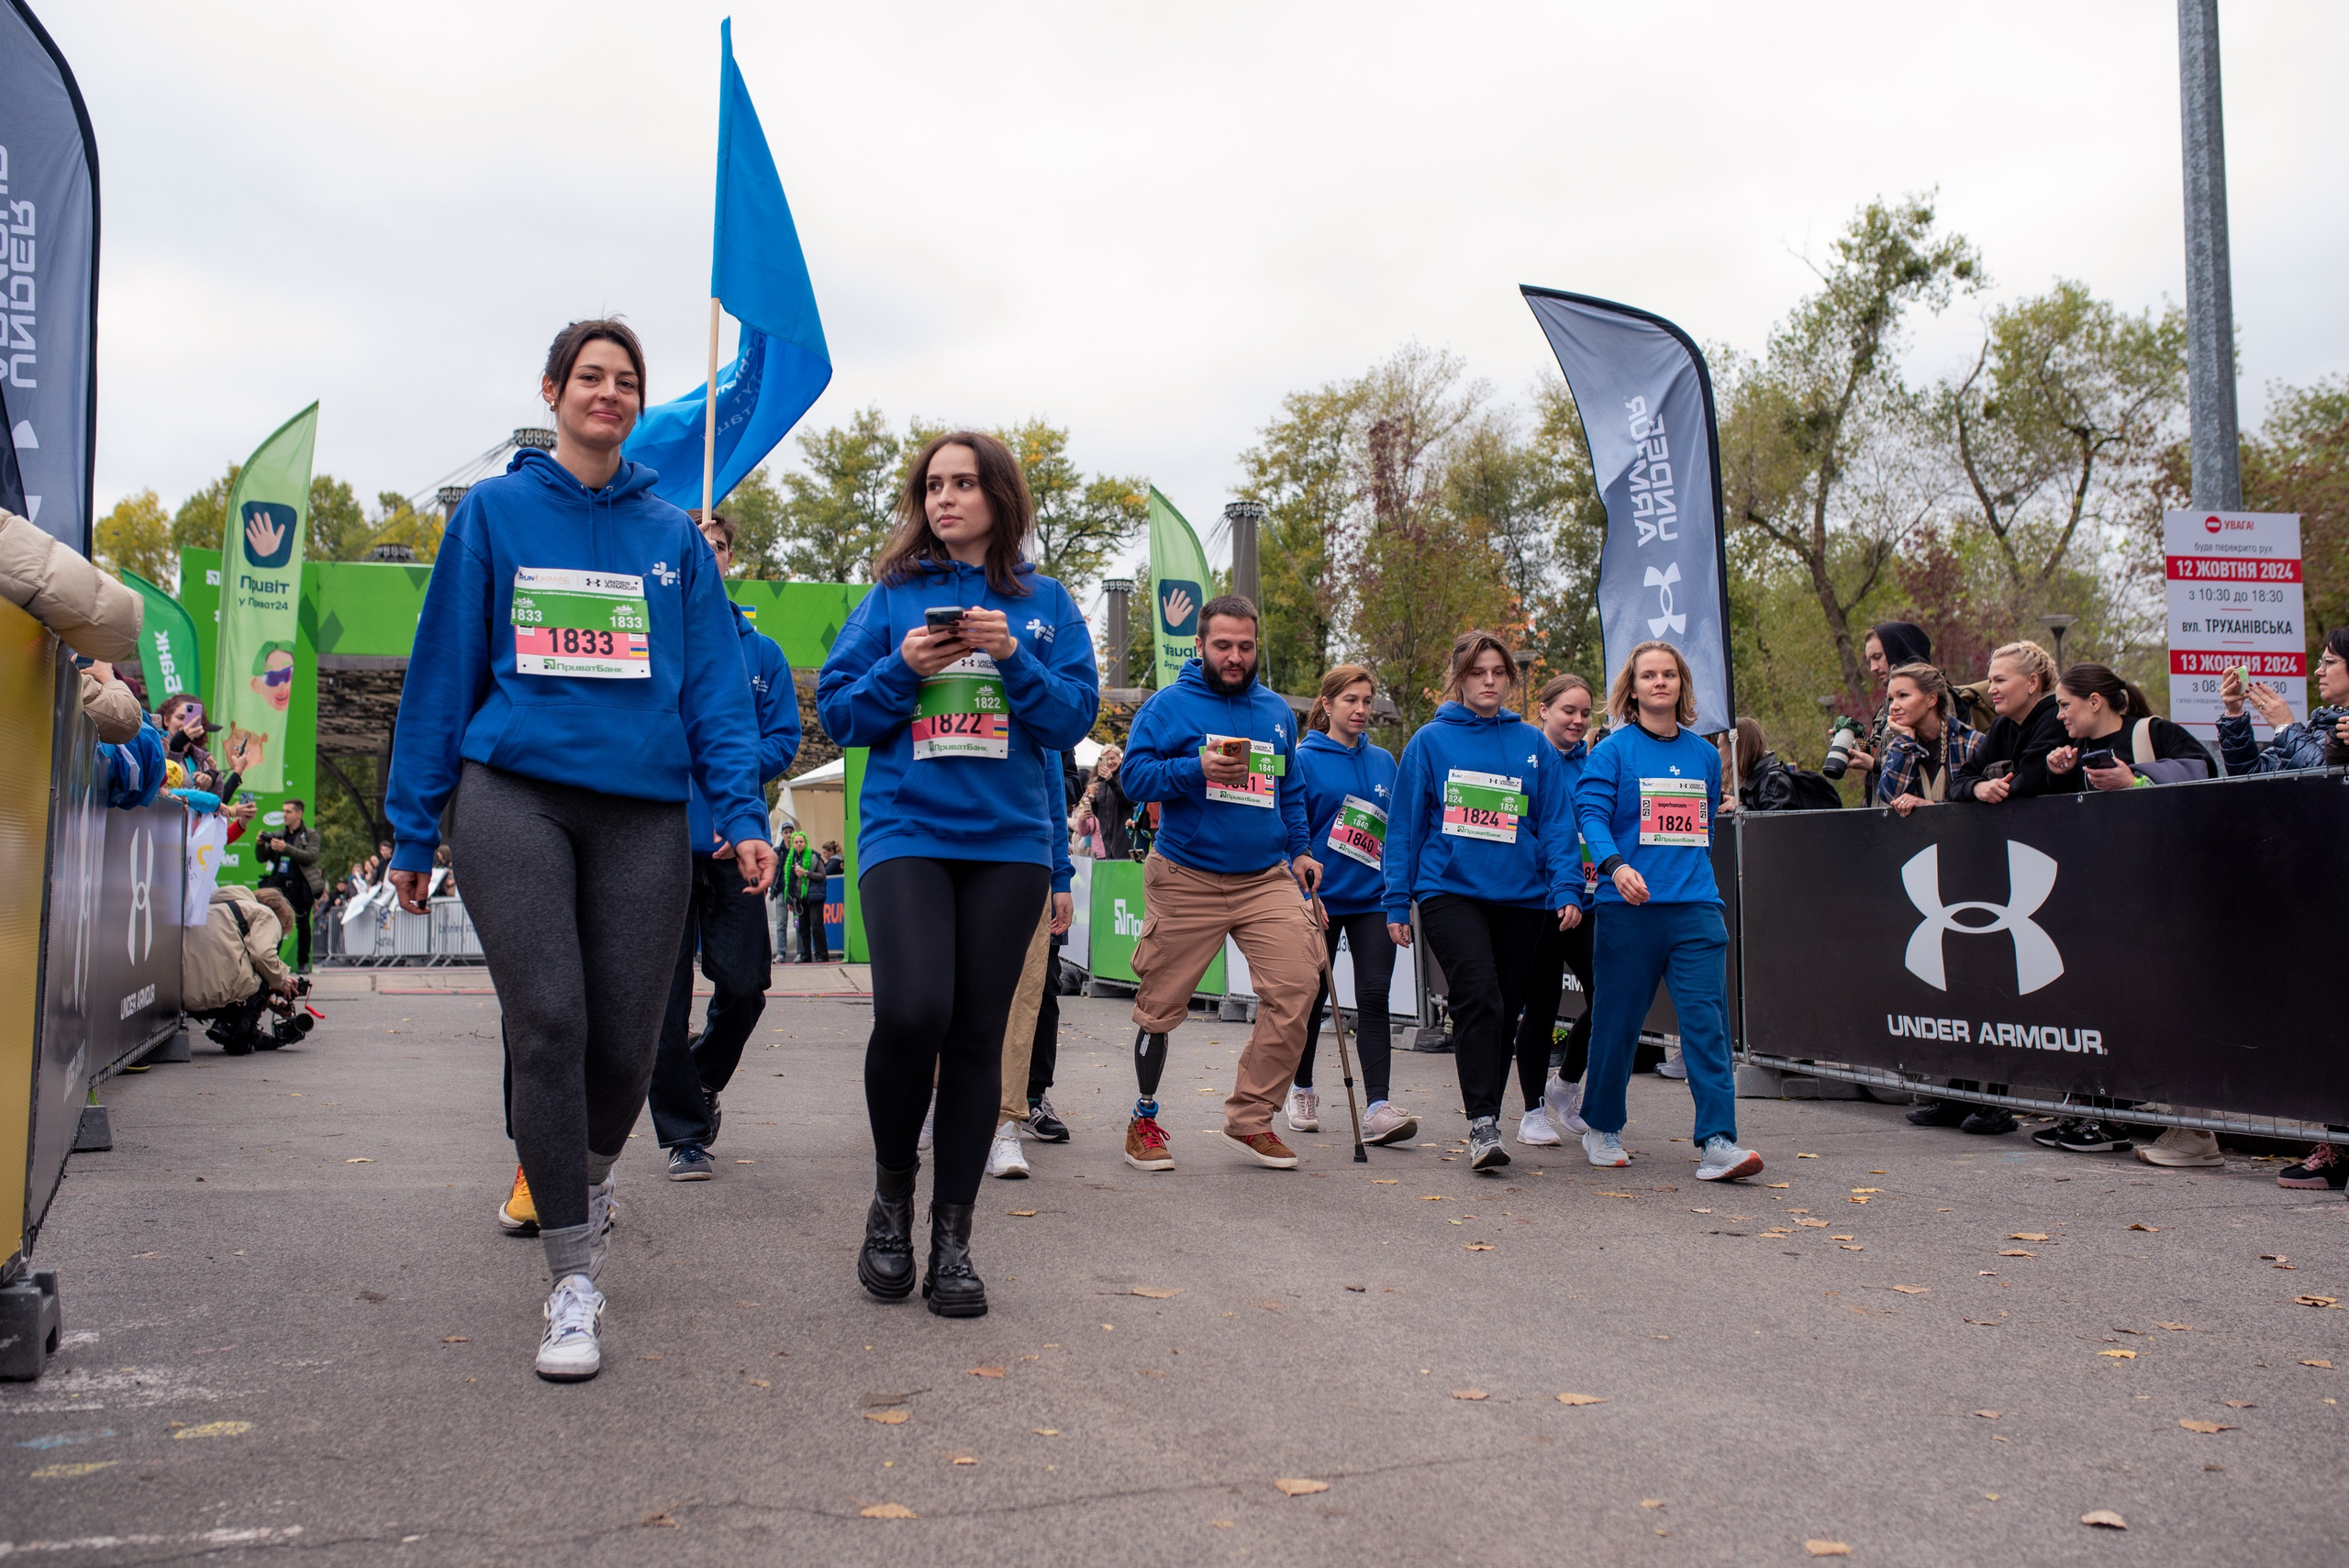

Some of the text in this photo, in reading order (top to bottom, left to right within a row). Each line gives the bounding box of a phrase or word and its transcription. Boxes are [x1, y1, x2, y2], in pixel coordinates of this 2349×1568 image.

[2224, 520, 2254, 530] УВАГА!
[2194, 541, 2274, 555] буде перекрито рух
[2176, 560, 2294, 580] 12 ЖОВТНЯ 2024
[240, 575, 290, 594] Привіт
[2199, 588, 2231, 601] 10:30
[2233, 592, 2248, 603] до
[2253, 589, 2284, 603] 18:30
[248, 596, 288, 611] Приват24
[511, 607, 542, 622] 1833
[609, 616, 643, 628] 1833
[2205, 618, 2293, 635] ТРУХАНІВСЬКА
[548, 628, 614, 655] 1833
[556, 662, 623, 673] ПриватБанк
[2180, 653, 2197, 671] 13
[2264, 656, 2298, 673] 2024
[974, 696, 1001, 709] 1822
[930, 712, 982, 735] 1822
[933, 743, 988, 752] ПриватБанк
[1258, 763, 1275, 773] 1841
[1500, 802, 1519, 812] 1824
[1353, 818, 1369, 829] 1840
[1463, 807, 1499, 827] 1824
[1657, 815, 1693, 832] 1826
[1347, 828, 1375, 853] 1840
[1887, 1013, 2104, 1055] UNDER ARMOUR
